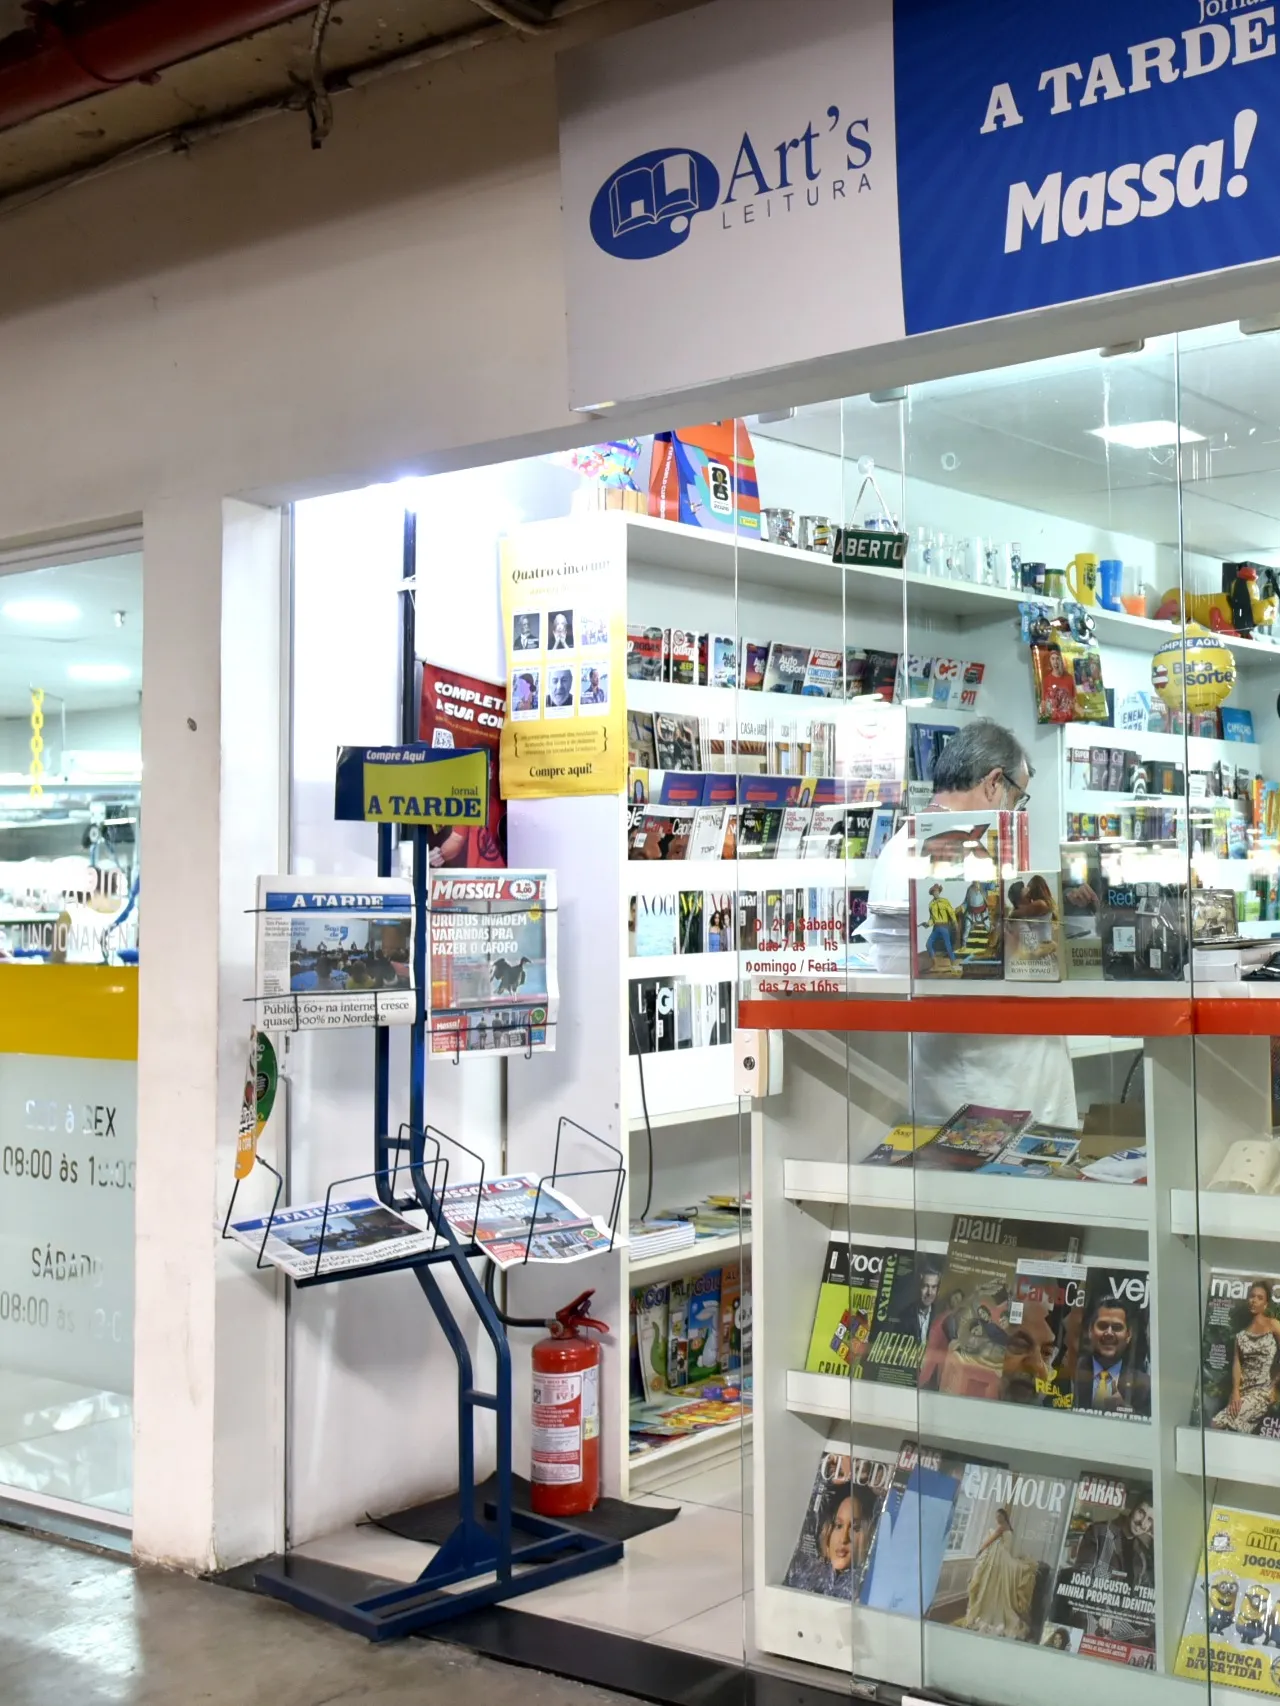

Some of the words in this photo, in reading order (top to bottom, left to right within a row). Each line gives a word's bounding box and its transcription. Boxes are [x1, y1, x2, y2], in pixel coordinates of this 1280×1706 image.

[980, 82, 1023, 134] A
[1038, 5, 1277, 116] TARDE
[719, 105, 873, 204] Art's
[1004, 108, 1258, 253] Massa!
[722, 173, 873, 230] LEITURA
[836, 533, 905, 561] ABERTO
[512, 565, 554, 583] Quatro
[1186, 669, 1233, 686] sorte
[366, 750, 401, 763] Compre
[402, 750, 426, 762] Aqui
[529, 764, 566, 779] Compre
[567, 763, 593, 778] aqui!
[368, 795, 384, 815] A
[388, 796, 481, 818] TARDE
[432, 877, 505, 901] Massa!
[292, 894, 307, 908] A
[312, 895, 384, 909] TARDE
[432, 914, 479, 927] URUBUS
[481, 913, 527, 926] INVADEM
[800, 916, 843, 932] Sábado
[432, 927, 490, 941] VARANDAS
[491, 927, 514, 940] PRA
[432, 942, 467, 956] FAZER
[470, 942, 479, 954] O
[480, 941, 519, 954] CAFOFO
[758, 938, 778, 952] das
[783, 939, 789, 951] 7
[792, 941, 806, 952] as
[824, 937, 839, 951] hs
[808, 959, 838, 973] Feria
[758, 979, 779, 993] das
[783, 980, 789, 993] 7
[793, 982, 807, 993] as
[811, 979, 840, 993] 16hs
[263, 1002, 301, 1016] Público
[303, 1001, 325, 1014] 60+
[326, 1003, 338, 1013] na
[340, 999, 377, 1013] interne
[380, 1001, 410, 1011] cresce
[263, 1016, 294, 1029] quase
[327, 1014, 341, 1024] no
[343, 1012, 387, 1024] Nordeste
[60, 1152, 78, 1184] às
[963, 1467, 1066, 1512] GLAMOUR
[1077, 1477, 1127, 1509] CARAS
[1056, 1583, 1085, 1600] MINHA
[1070, 1571, 1091, 1588] JOÃO
[1092, 1577, 1132, 1596] AUGUSTO:
[1197, 1646, 1263, 1670] BAGUNÇA
[1186, 1656, 1263, 1681] DIVERTIDA!
